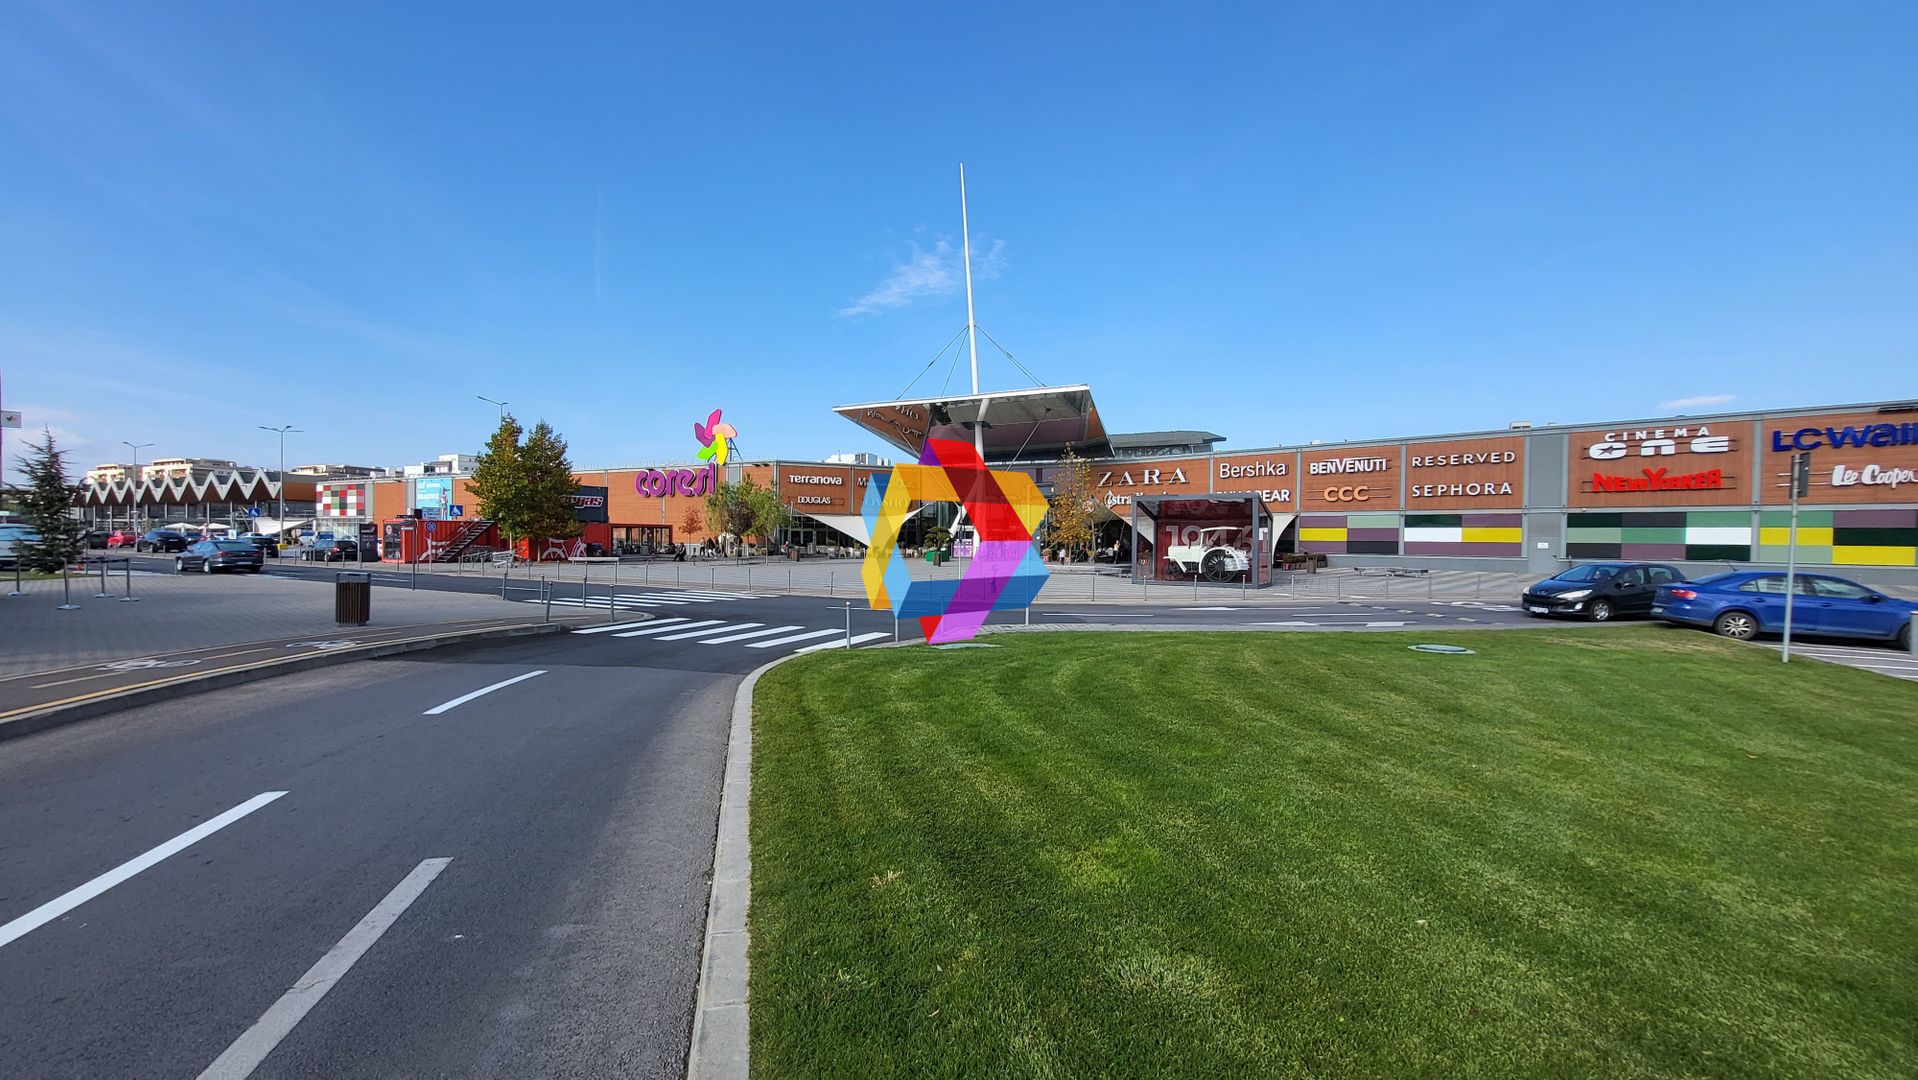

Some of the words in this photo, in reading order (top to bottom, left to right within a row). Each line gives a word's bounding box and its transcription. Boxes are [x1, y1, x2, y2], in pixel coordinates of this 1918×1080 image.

[1604, 427, 1709, 442] CINEMA
[1309, 458, 1387, 475] BENVENUTI
[1412, 451, 1516, 467] RESERVED
[1097, 467, 1189, 487] ZARA
[1219, 460, 1287, 478] Bershka
[1831, 464, 1859, 488] Lee
[1861, 464, 1918, 489] Cooper
[1323, 485, 1370, 502] CCC
[1412, 481, 1513, 497] SEPHORA
[797, 495, 831, 504] DOUGLAS
